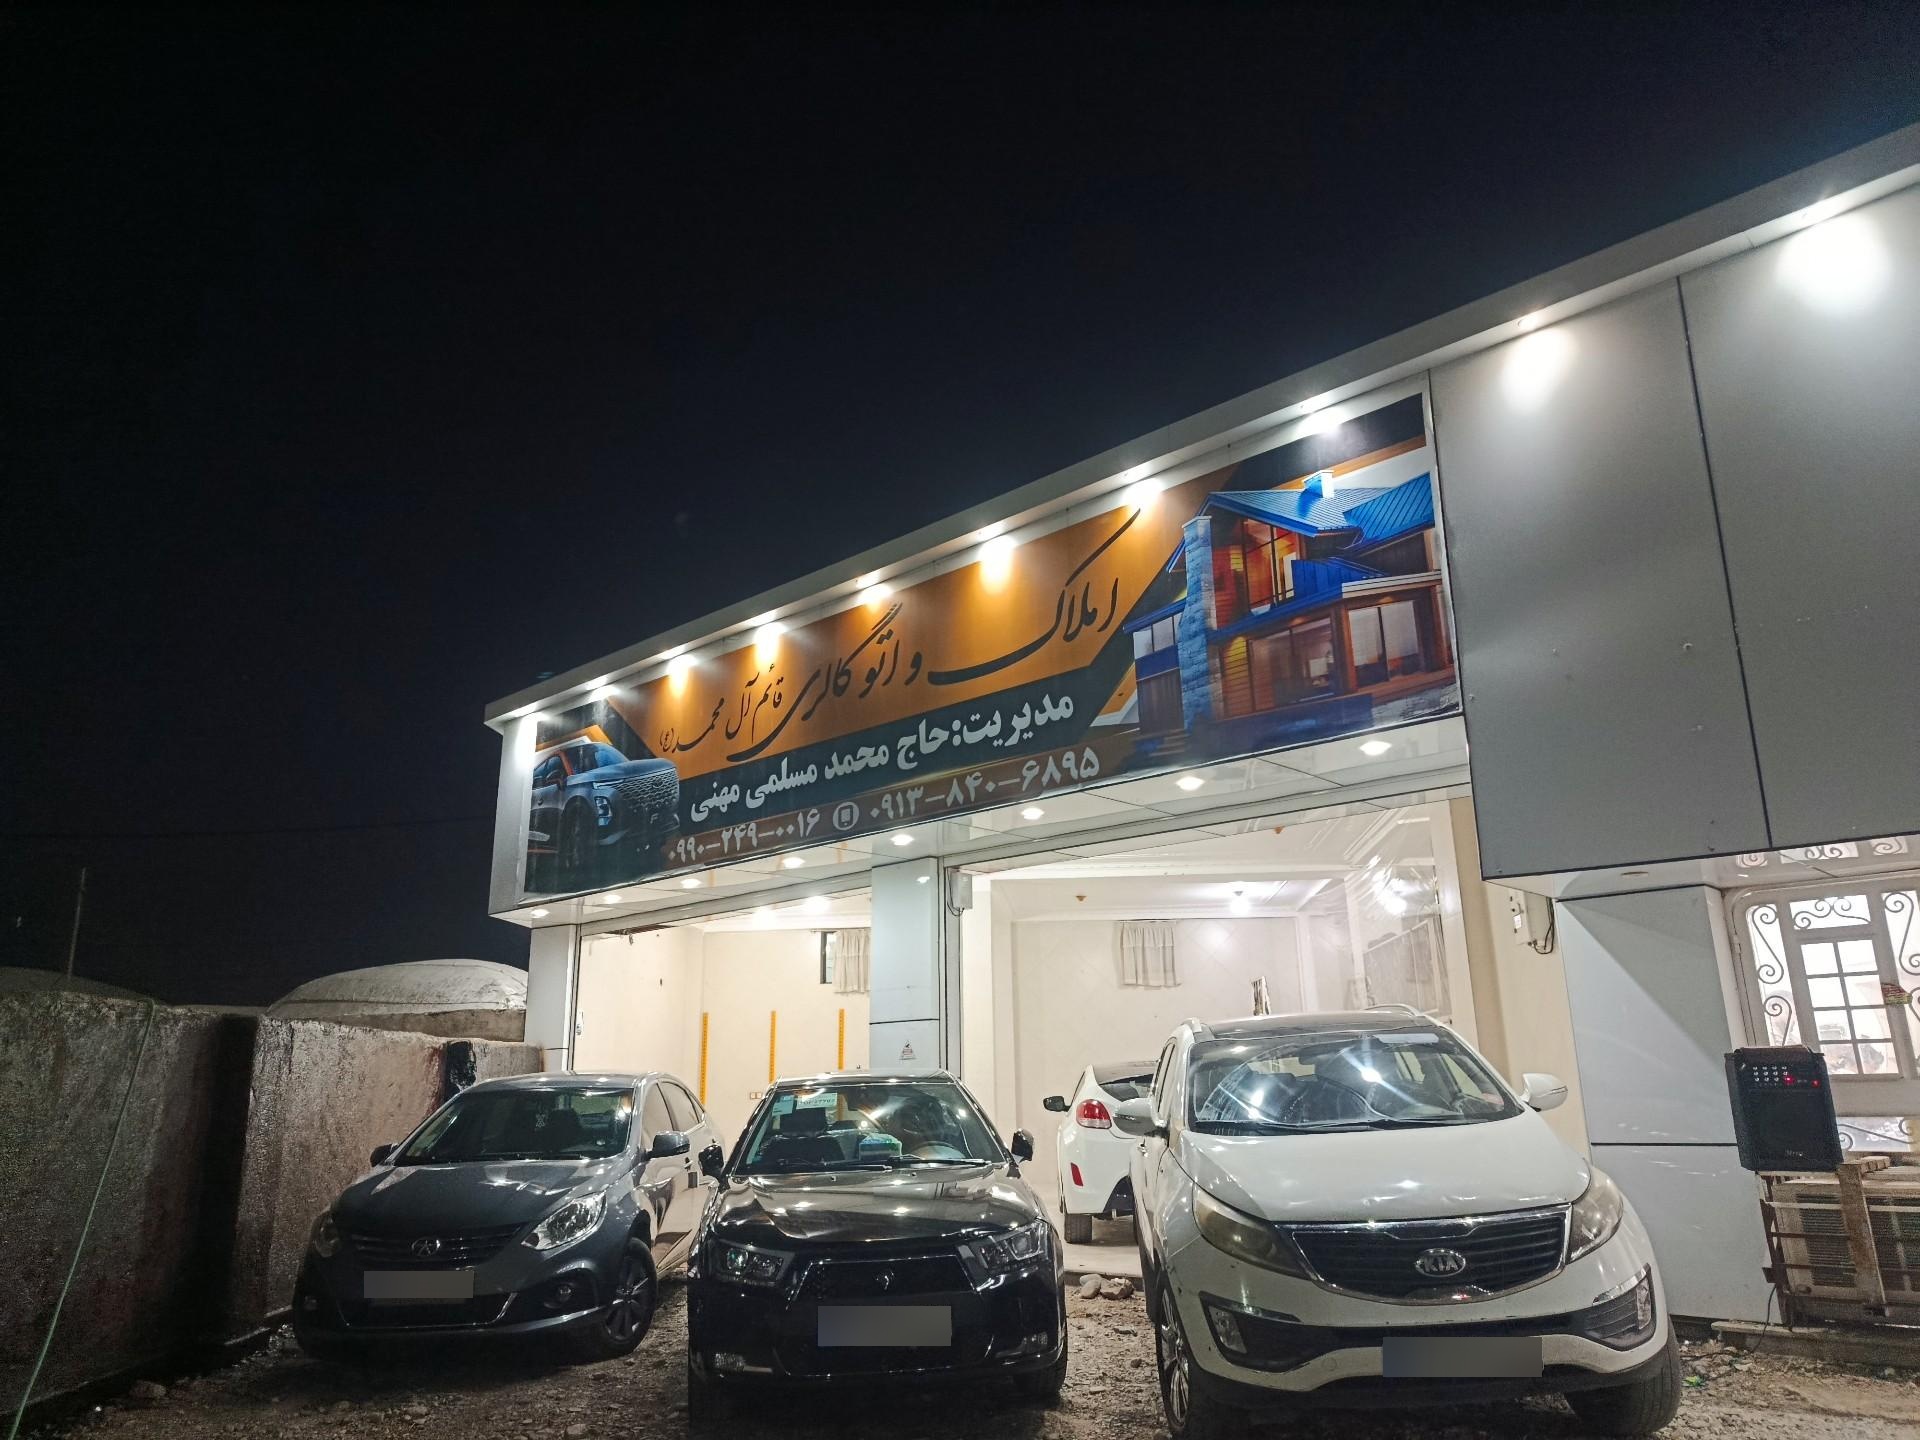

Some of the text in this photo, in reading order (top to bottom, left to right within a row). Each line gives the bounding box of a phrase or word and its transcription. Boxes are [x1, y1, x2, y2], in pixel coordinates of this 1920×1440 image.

[927, 508, 1141, 686] املاک
[904, 651, 922, 686] و
[824, 744, 890, 780] محمد
[690, 781, 740, 822] مهنی
[745, 757, 818, 809] مسلمی
[1424, 1254, 1459, 1272] KIA
